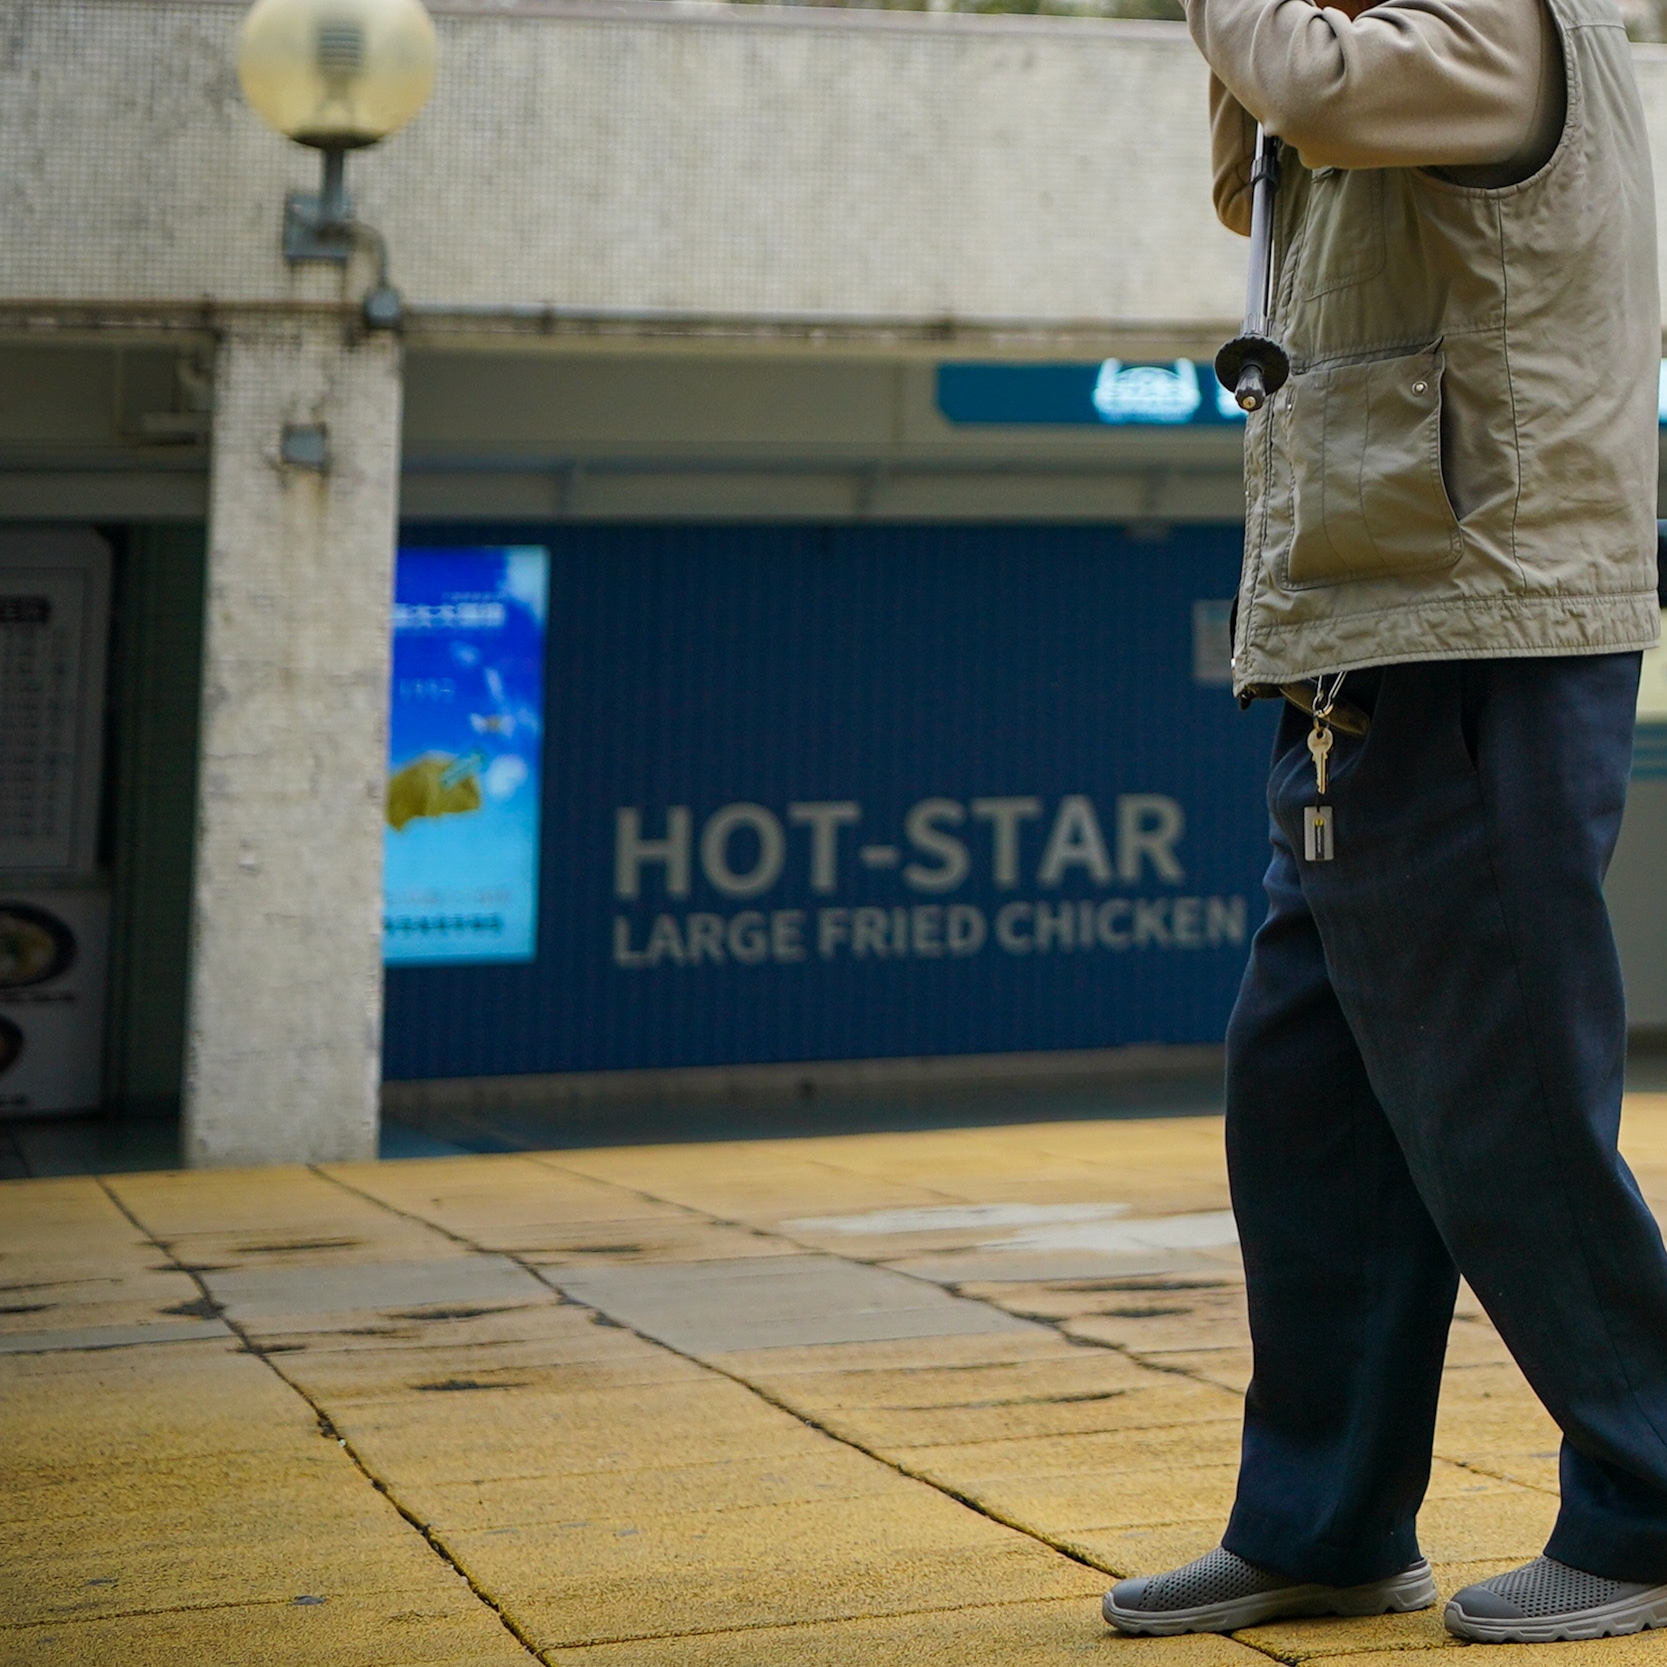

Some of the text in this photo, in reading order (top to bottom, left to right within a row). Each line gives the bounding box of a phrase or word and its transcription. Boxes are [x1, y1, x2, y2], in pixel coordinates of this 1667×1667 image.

[613, 793, 1186, 899] HOT-STAR
[612, 895, 1247, 968] LARGE FRIED CHICKEN
